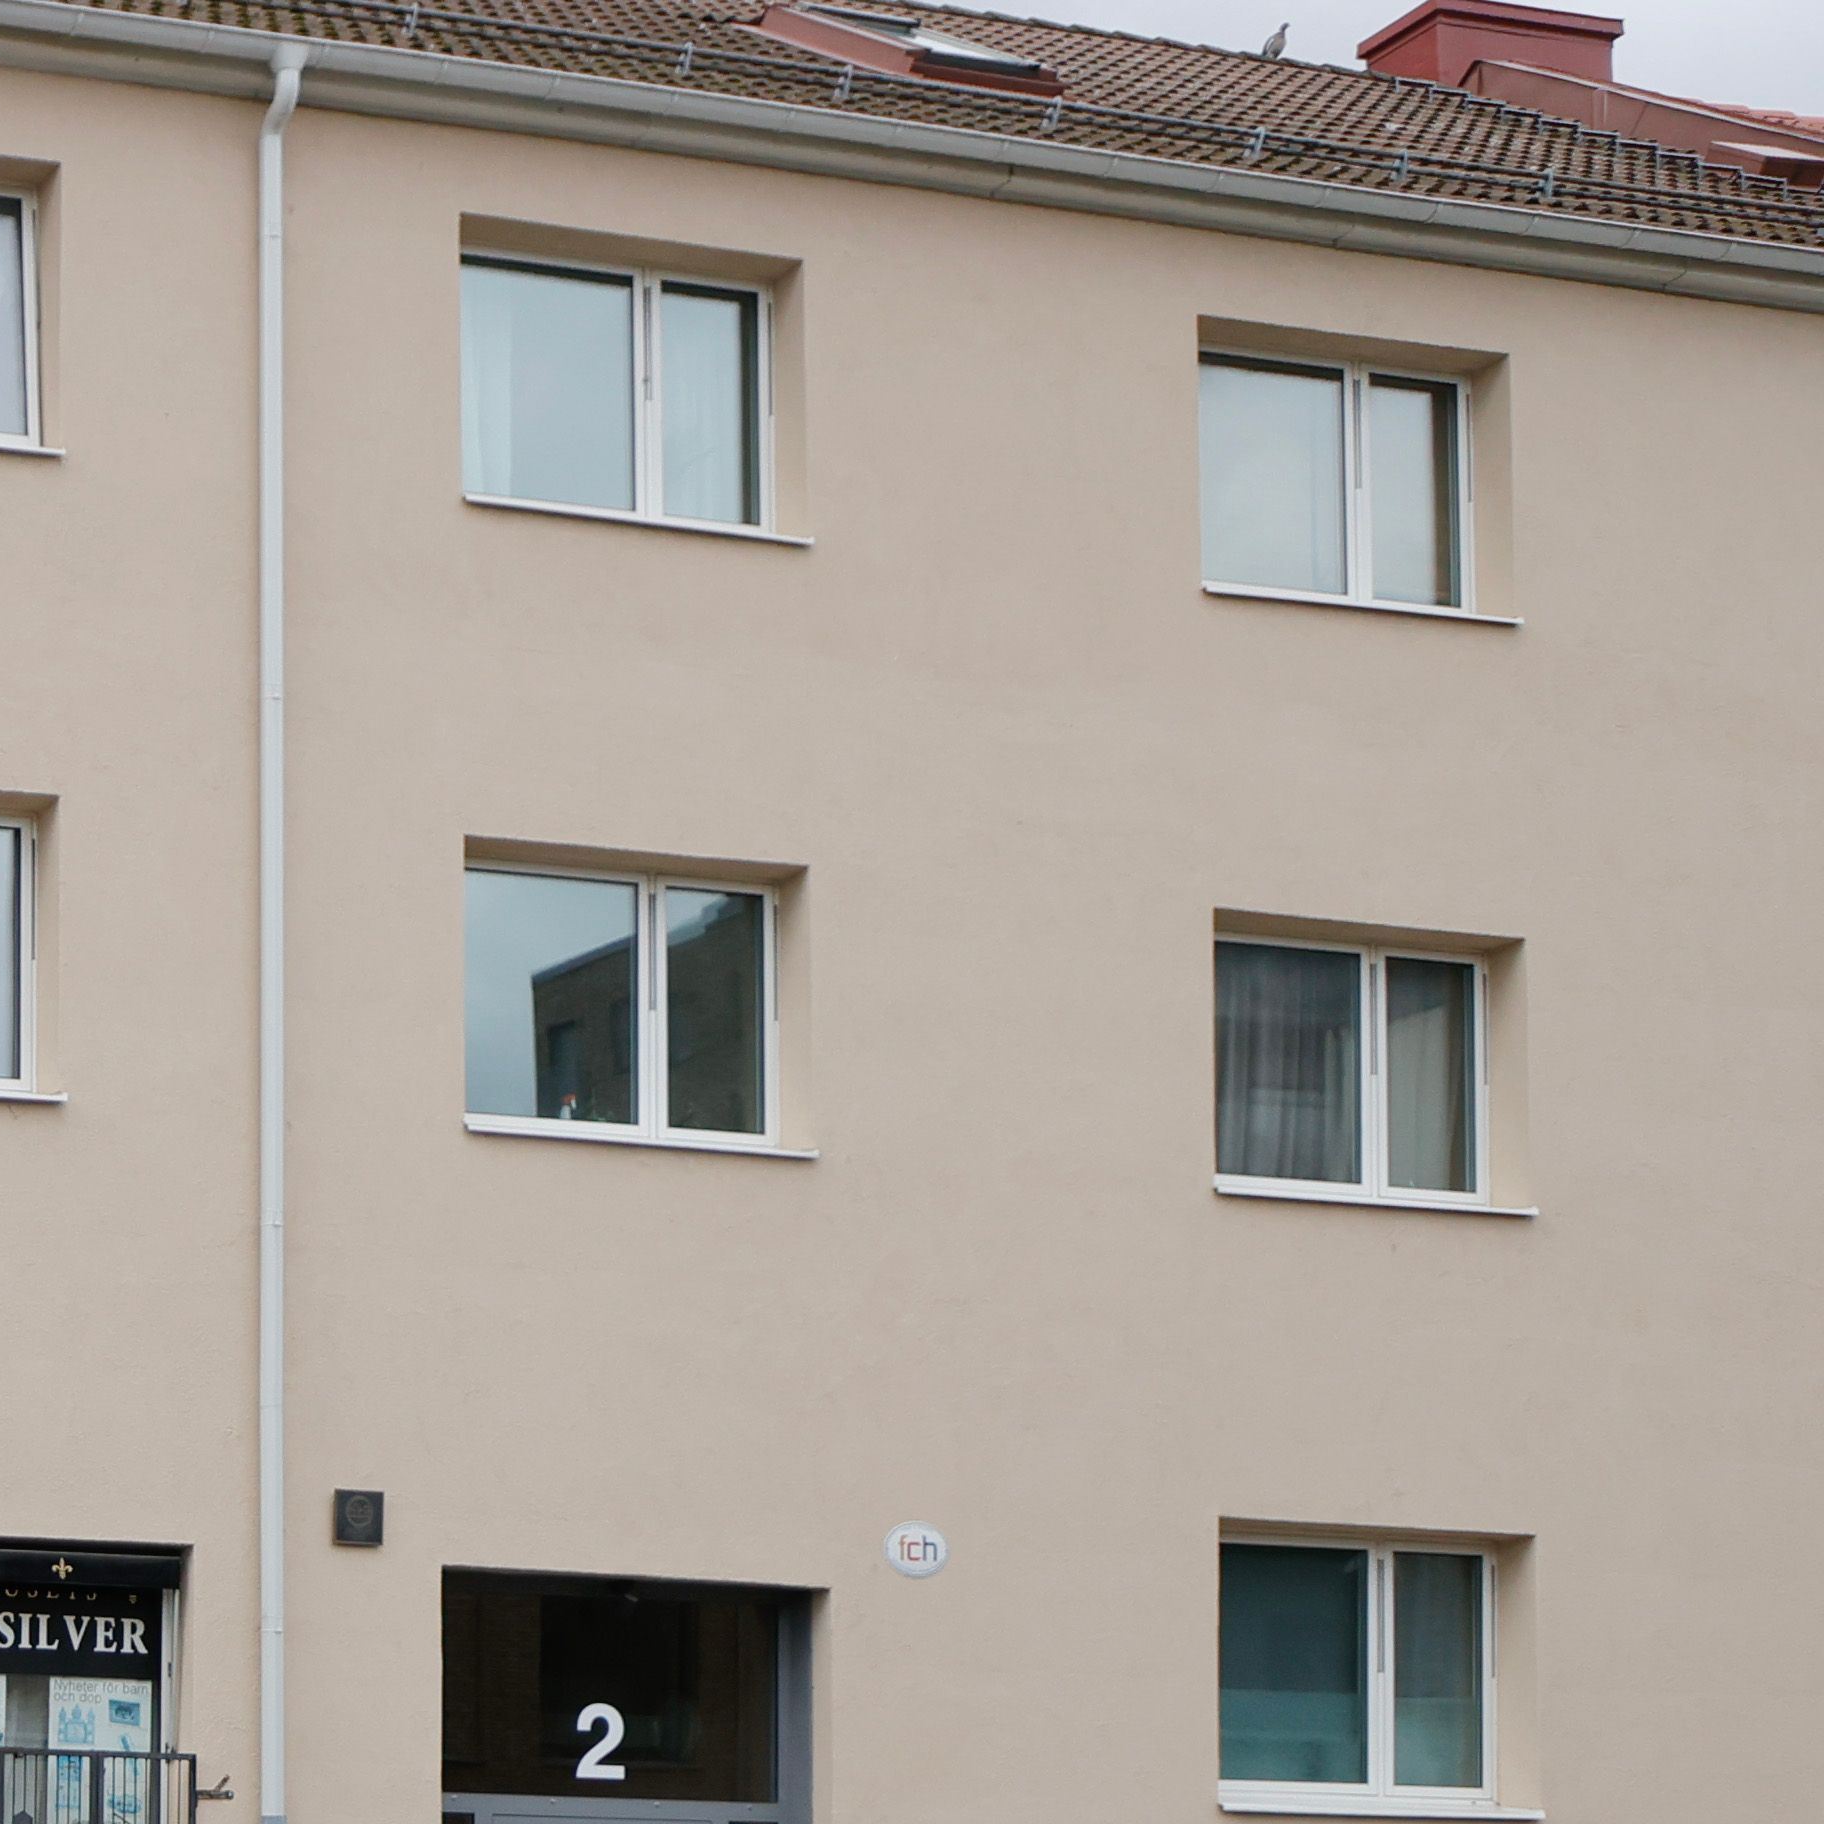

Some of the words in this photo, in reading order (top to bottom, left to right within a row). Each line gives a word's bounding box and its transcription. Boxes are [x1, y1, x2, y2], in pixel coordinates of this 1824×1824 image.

[898, 1534, 938, 1562] fch
[53, 1679, 98, 1693] Nyheter
[122, 1683, 148, 1695] barn
[575, 1702, 626, 1780] 2
